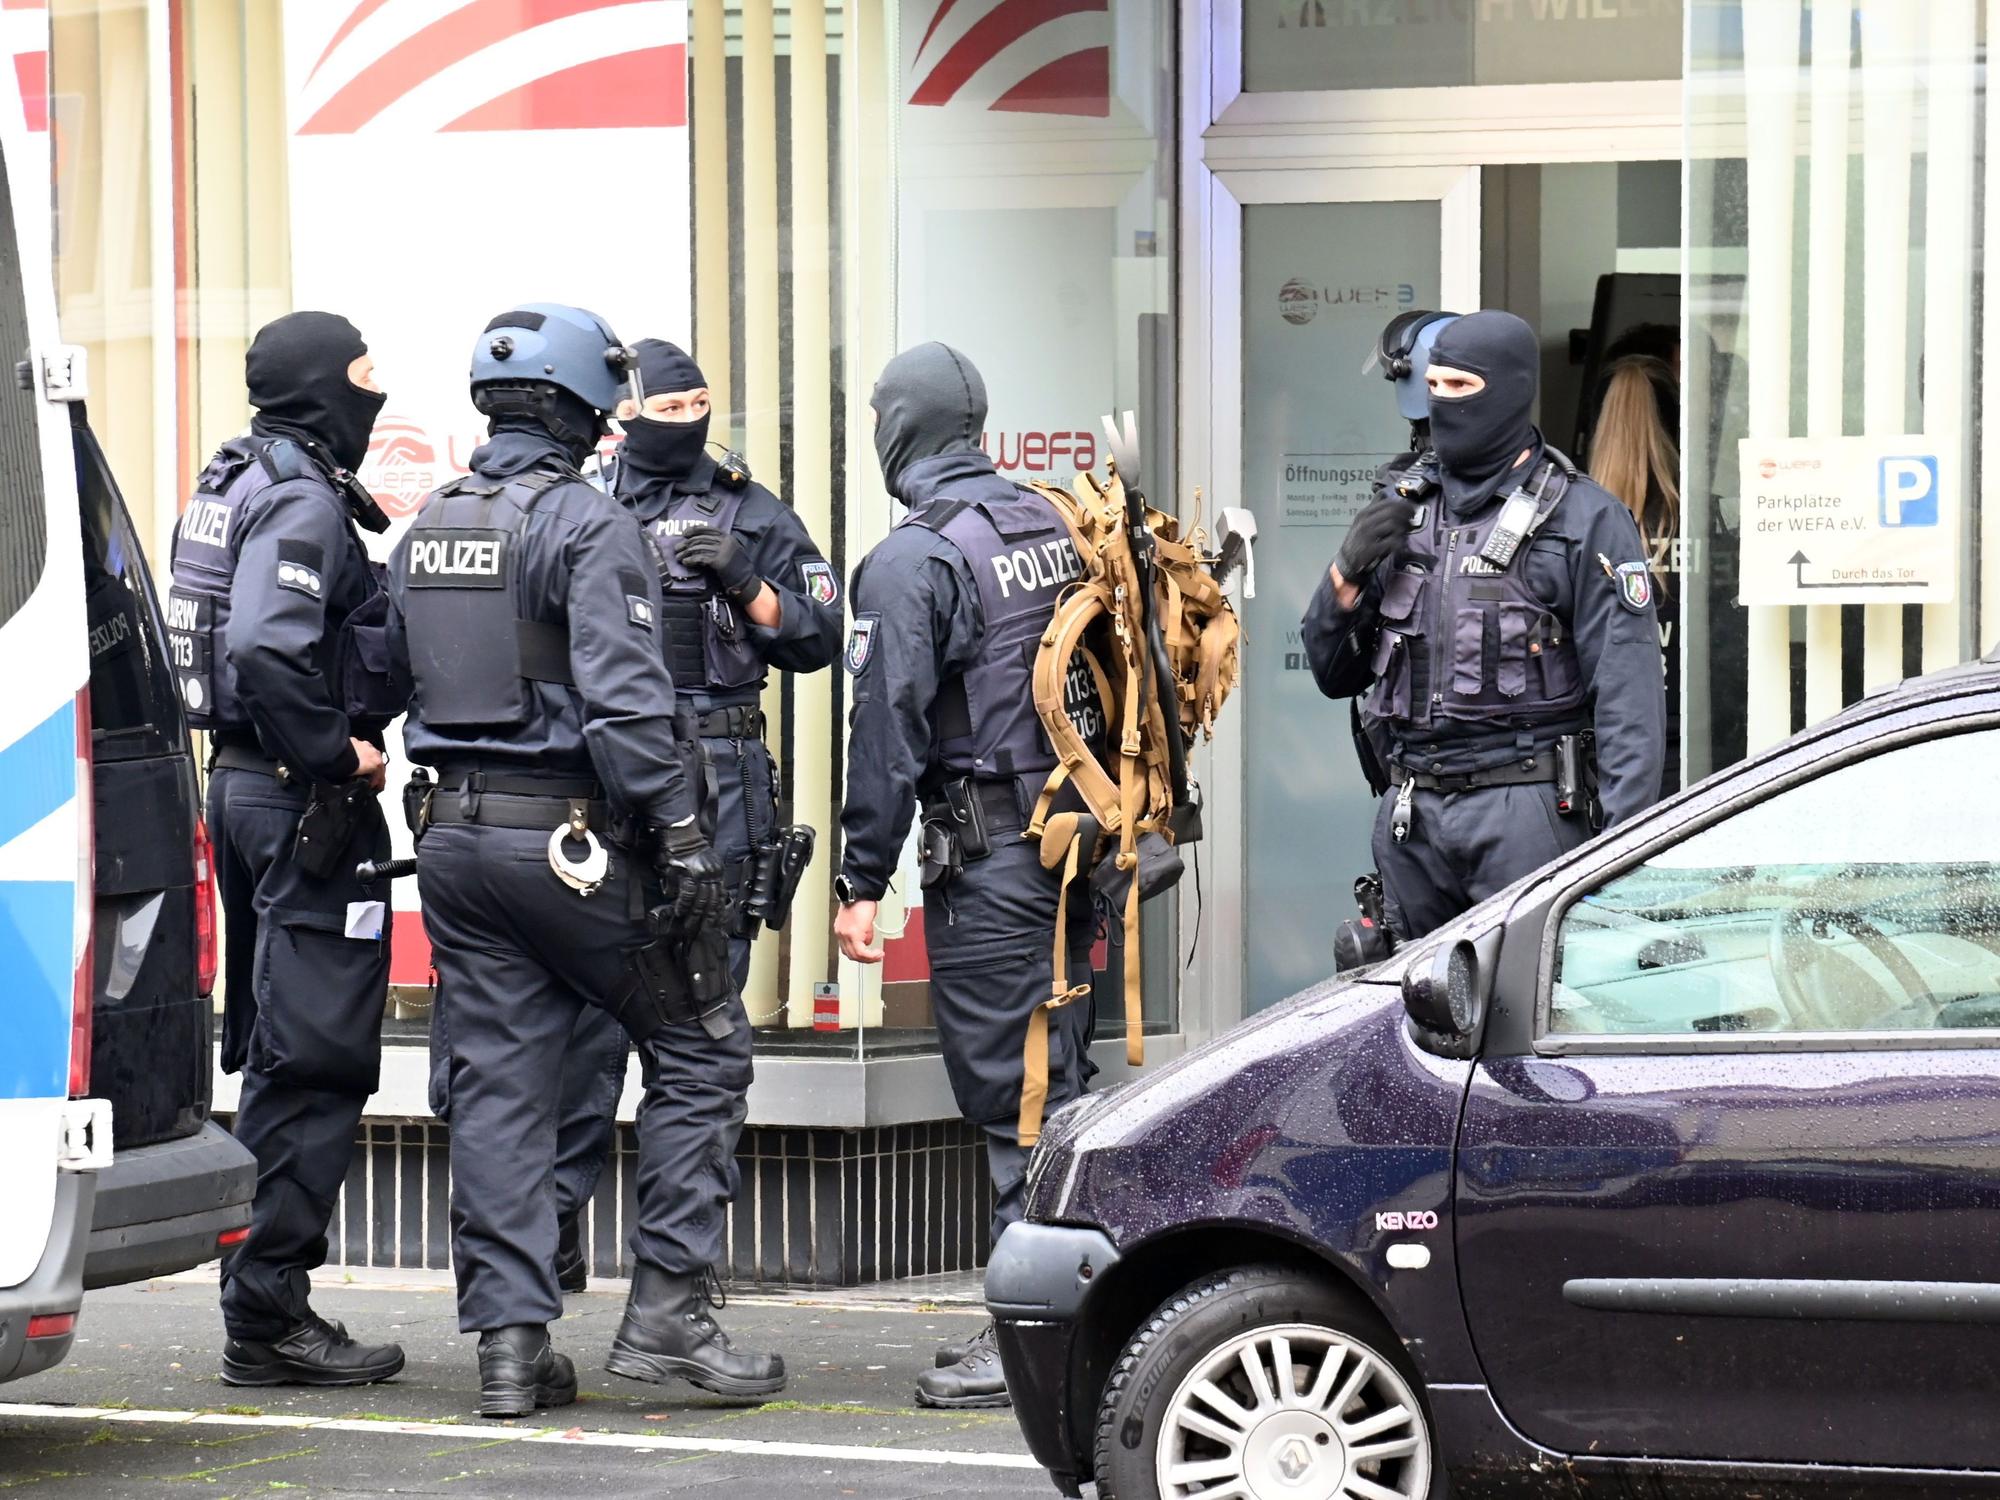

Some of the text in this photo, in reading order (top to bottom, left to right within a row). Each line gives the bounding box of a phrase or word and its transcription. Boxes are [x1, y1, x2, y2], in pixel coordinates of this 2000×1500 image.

[1757, 494, 1842, 511] Parkplätze
[1757, 516, 1867, 532] der WEFA e.V.
[410, 540, 501, 575] POLIZEI
[1832, 567, 1915, 580] Durch das Tor
[1375, 1210, 1438, 1231] KENZO
